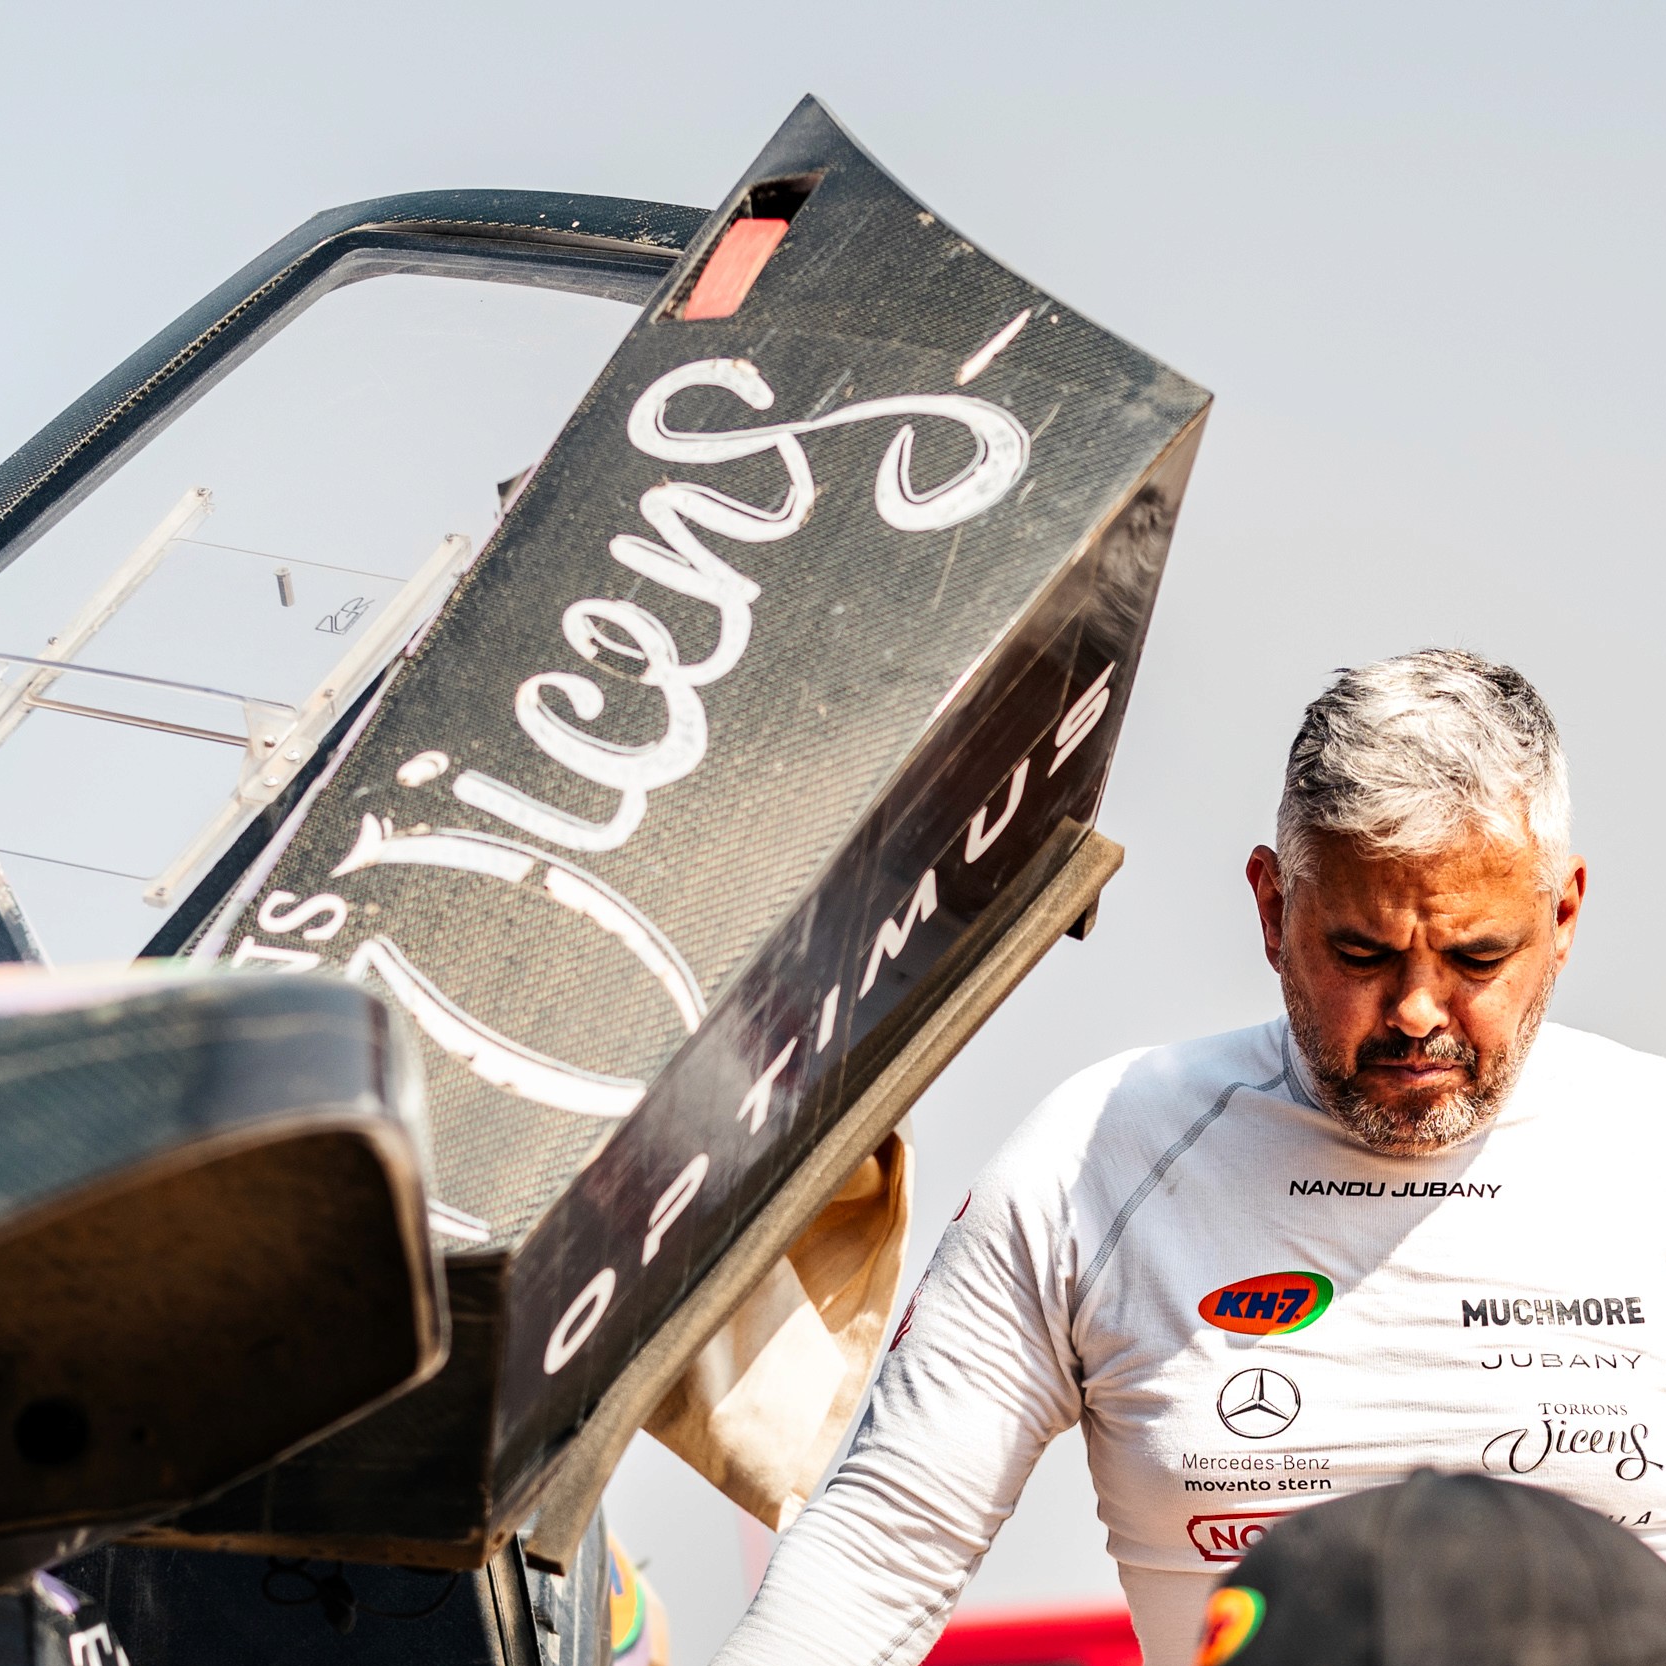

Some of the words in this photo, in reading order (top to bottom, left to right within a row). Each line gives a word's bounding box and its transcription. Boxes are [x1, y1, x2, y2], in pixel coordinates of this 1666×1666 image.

[544, 660, 1116, 1376] OPTIMUS
[1289, 1179, 1386, 1198] NANDU
[1391, 1181, 1502, 1199] JUBANY
[1461, 1297, 1646, 1328] MUCHMORE
[1481, 1353, 1642, 1370] JUBANY
[1538, 1402, 1629, 1416] TORRONS
[1481, 1419, 1664, 1482] Vicens
[1182, 1453, 1331, 1471] Mercedes-Benz
[1277, 1478, 1332, 1491] stern
